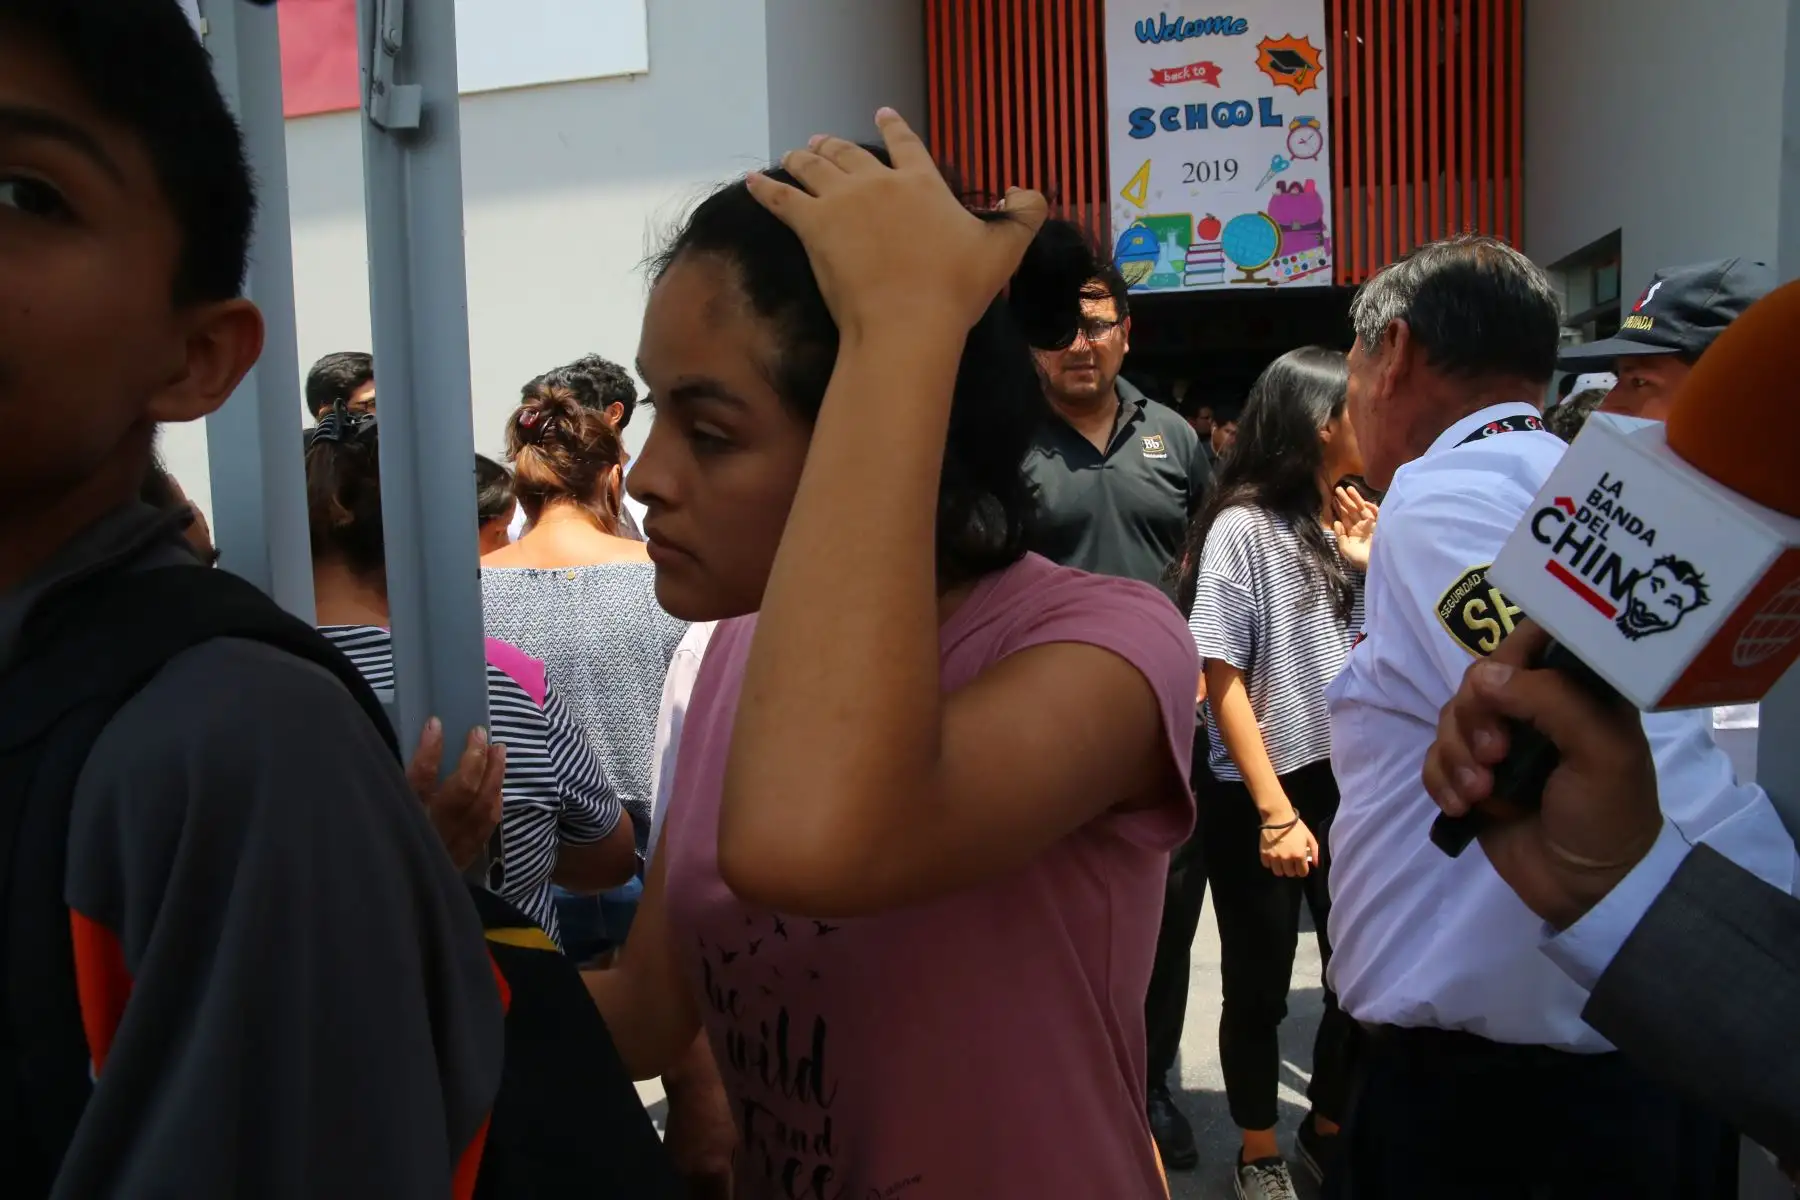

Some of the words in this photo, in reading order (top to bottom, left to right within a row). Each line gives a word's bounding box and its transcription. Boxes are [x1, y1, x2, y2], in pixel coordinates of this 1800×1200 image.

[1135, 12, 1249, 44] Welcome
[1163, 66, 1190, 81] back
[1193, 66, 1206, 76] to
[1128, 97, 1283, 139] SCHOOL
[1182, 158, 1239, 184] 2019
[1597, 472, 1624, 499] LA
[1574, 506, 1611, 541] DEL
[1585, 489, 1657, 547] BANDA
[1440, 573, 1482, 620] SEGURIDAD
[726, 1005, 839, 1108] wild
